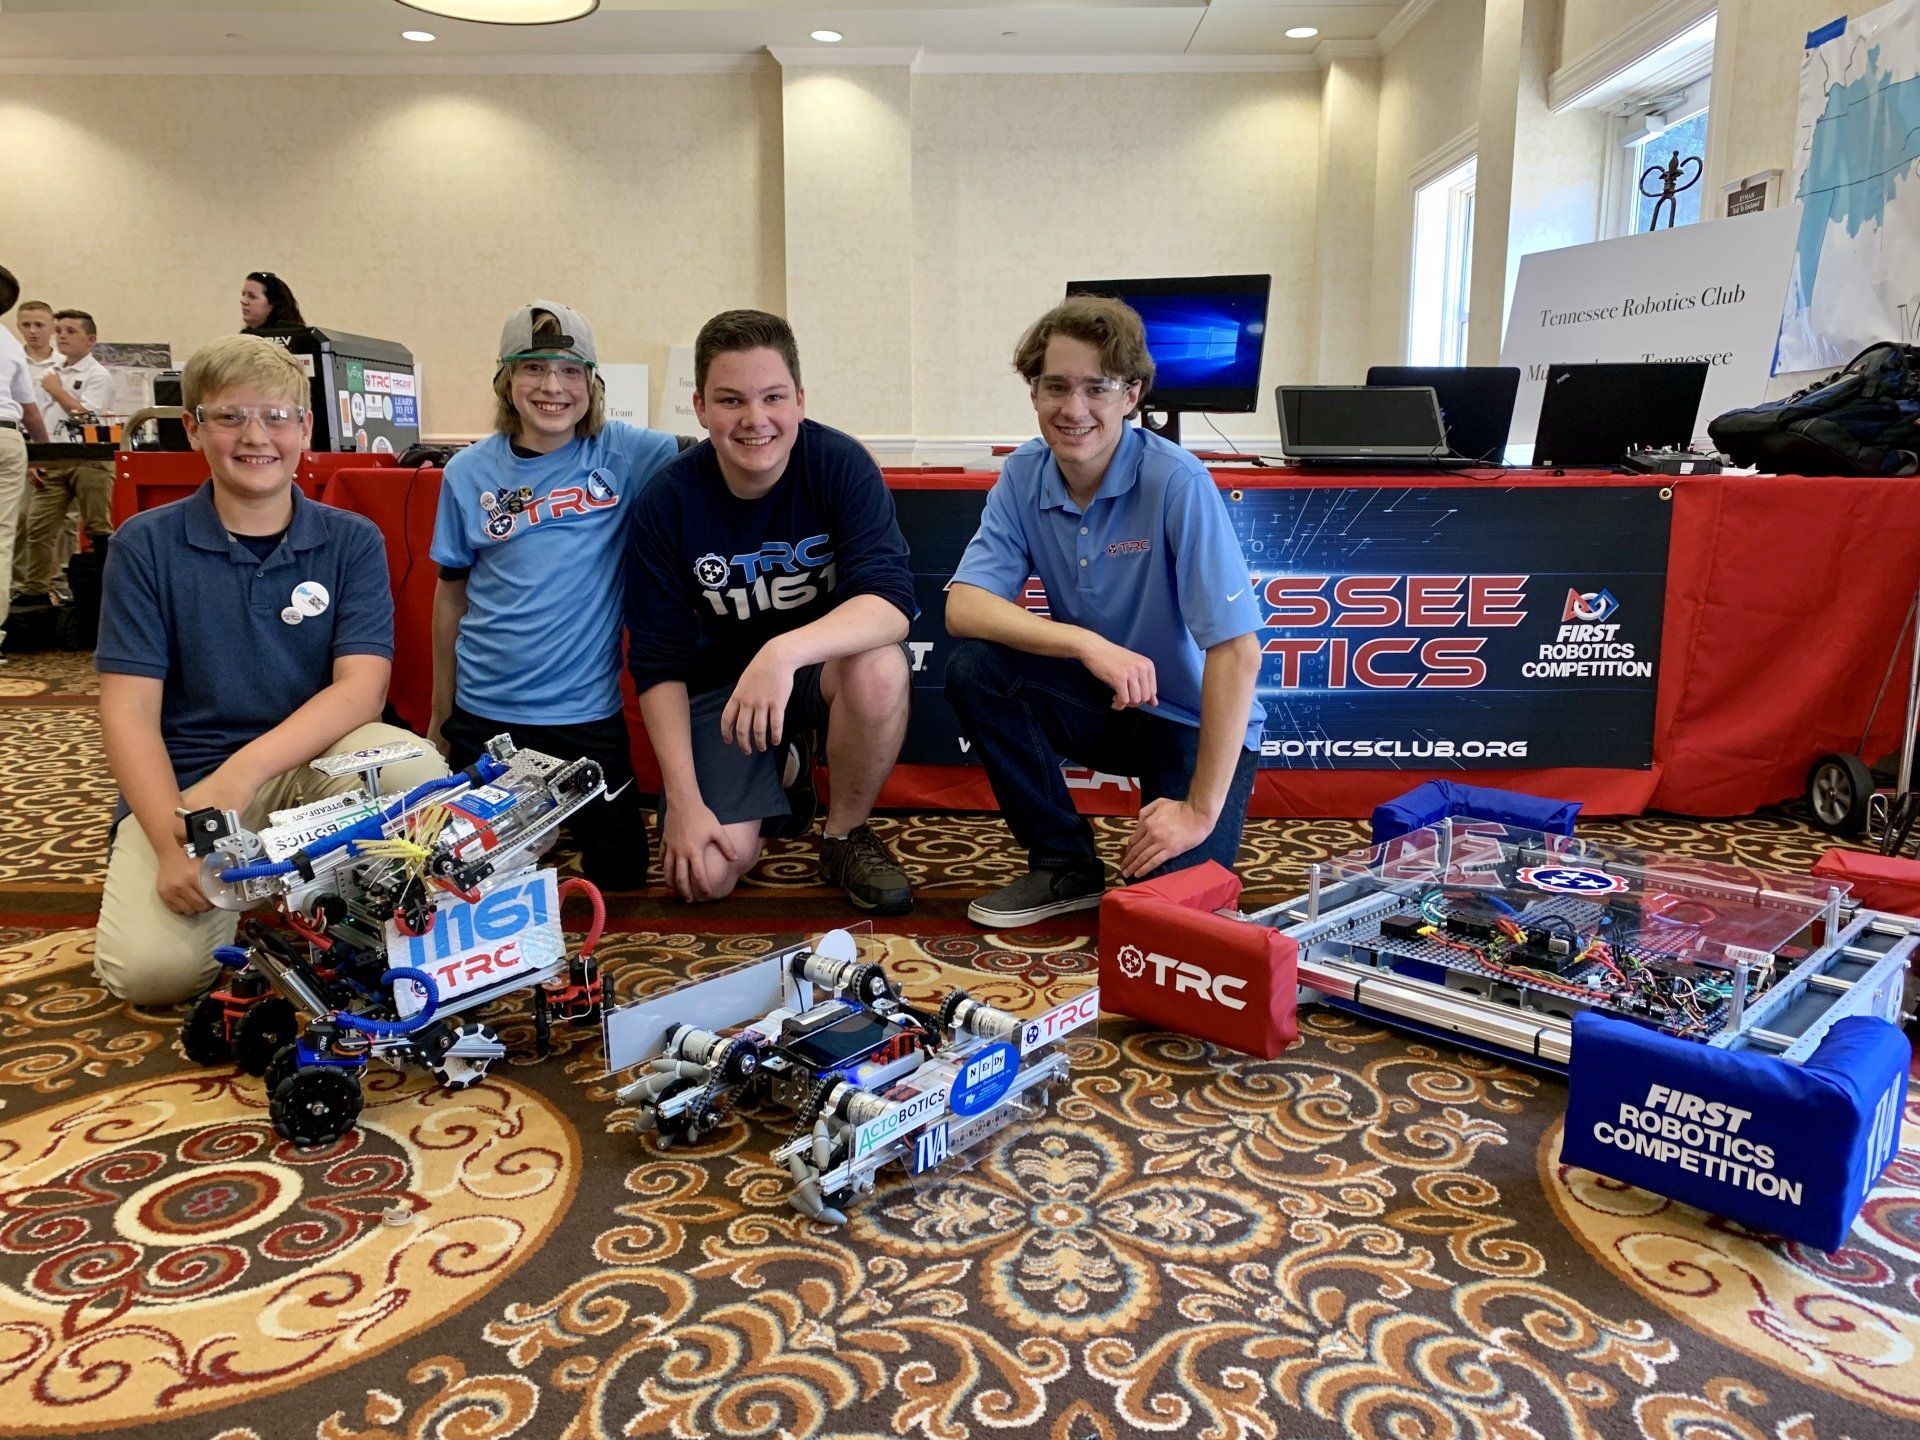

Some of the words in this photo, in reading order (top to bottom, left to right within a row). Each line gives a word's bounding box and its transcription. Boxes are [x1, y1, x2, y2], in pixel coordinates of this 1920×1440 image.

[1540, 303, 1619, 328] Tennessee
[1622, 290, 1697, 318] Robotics
[1700, 284, 1746, 307] Club
[371, 375, 390, 389] TRC
[394, 397, 414, 407] LEARN
[395, 406, 403, 415] TO
[404, 406, 414, 415] FLY
[609, 407, 633, 418] Team
[591, 470, 616, 499] DRIVER
[730, 534, 835, 583] TRC
[1118, 539, 1151, 554] TRC
[702, 562, 836, 620] 11161
[1252, 575, 1531, 628] SSEE
[1539, 643, 1635, 660] ROBOTICS
[1556, 624, 1620, 643] FIRST
[1261, 637, 1488, 689] TICS
[1521, 661, 1653, 678] COMPETITION
[1260, 740, 1528, 758] BOTICSCLUB.ORG
[437, 942, 521, 987] TRC
[1145, 952, 1248, 1011] TRC
[1043, 995, 1095, 1037] TRC
[970, 1066, 977, 1079] N
[857, 1088, 945, 1157] ACTOBOTICS
[1645, 1083, 1752, 1133] FIRST
[917, 1123, 948, 1174] TVA
[1619, 1102, 1775, 1170] ROBOTICS
[1594, 1121, 1803, 1206] COMPETITION
